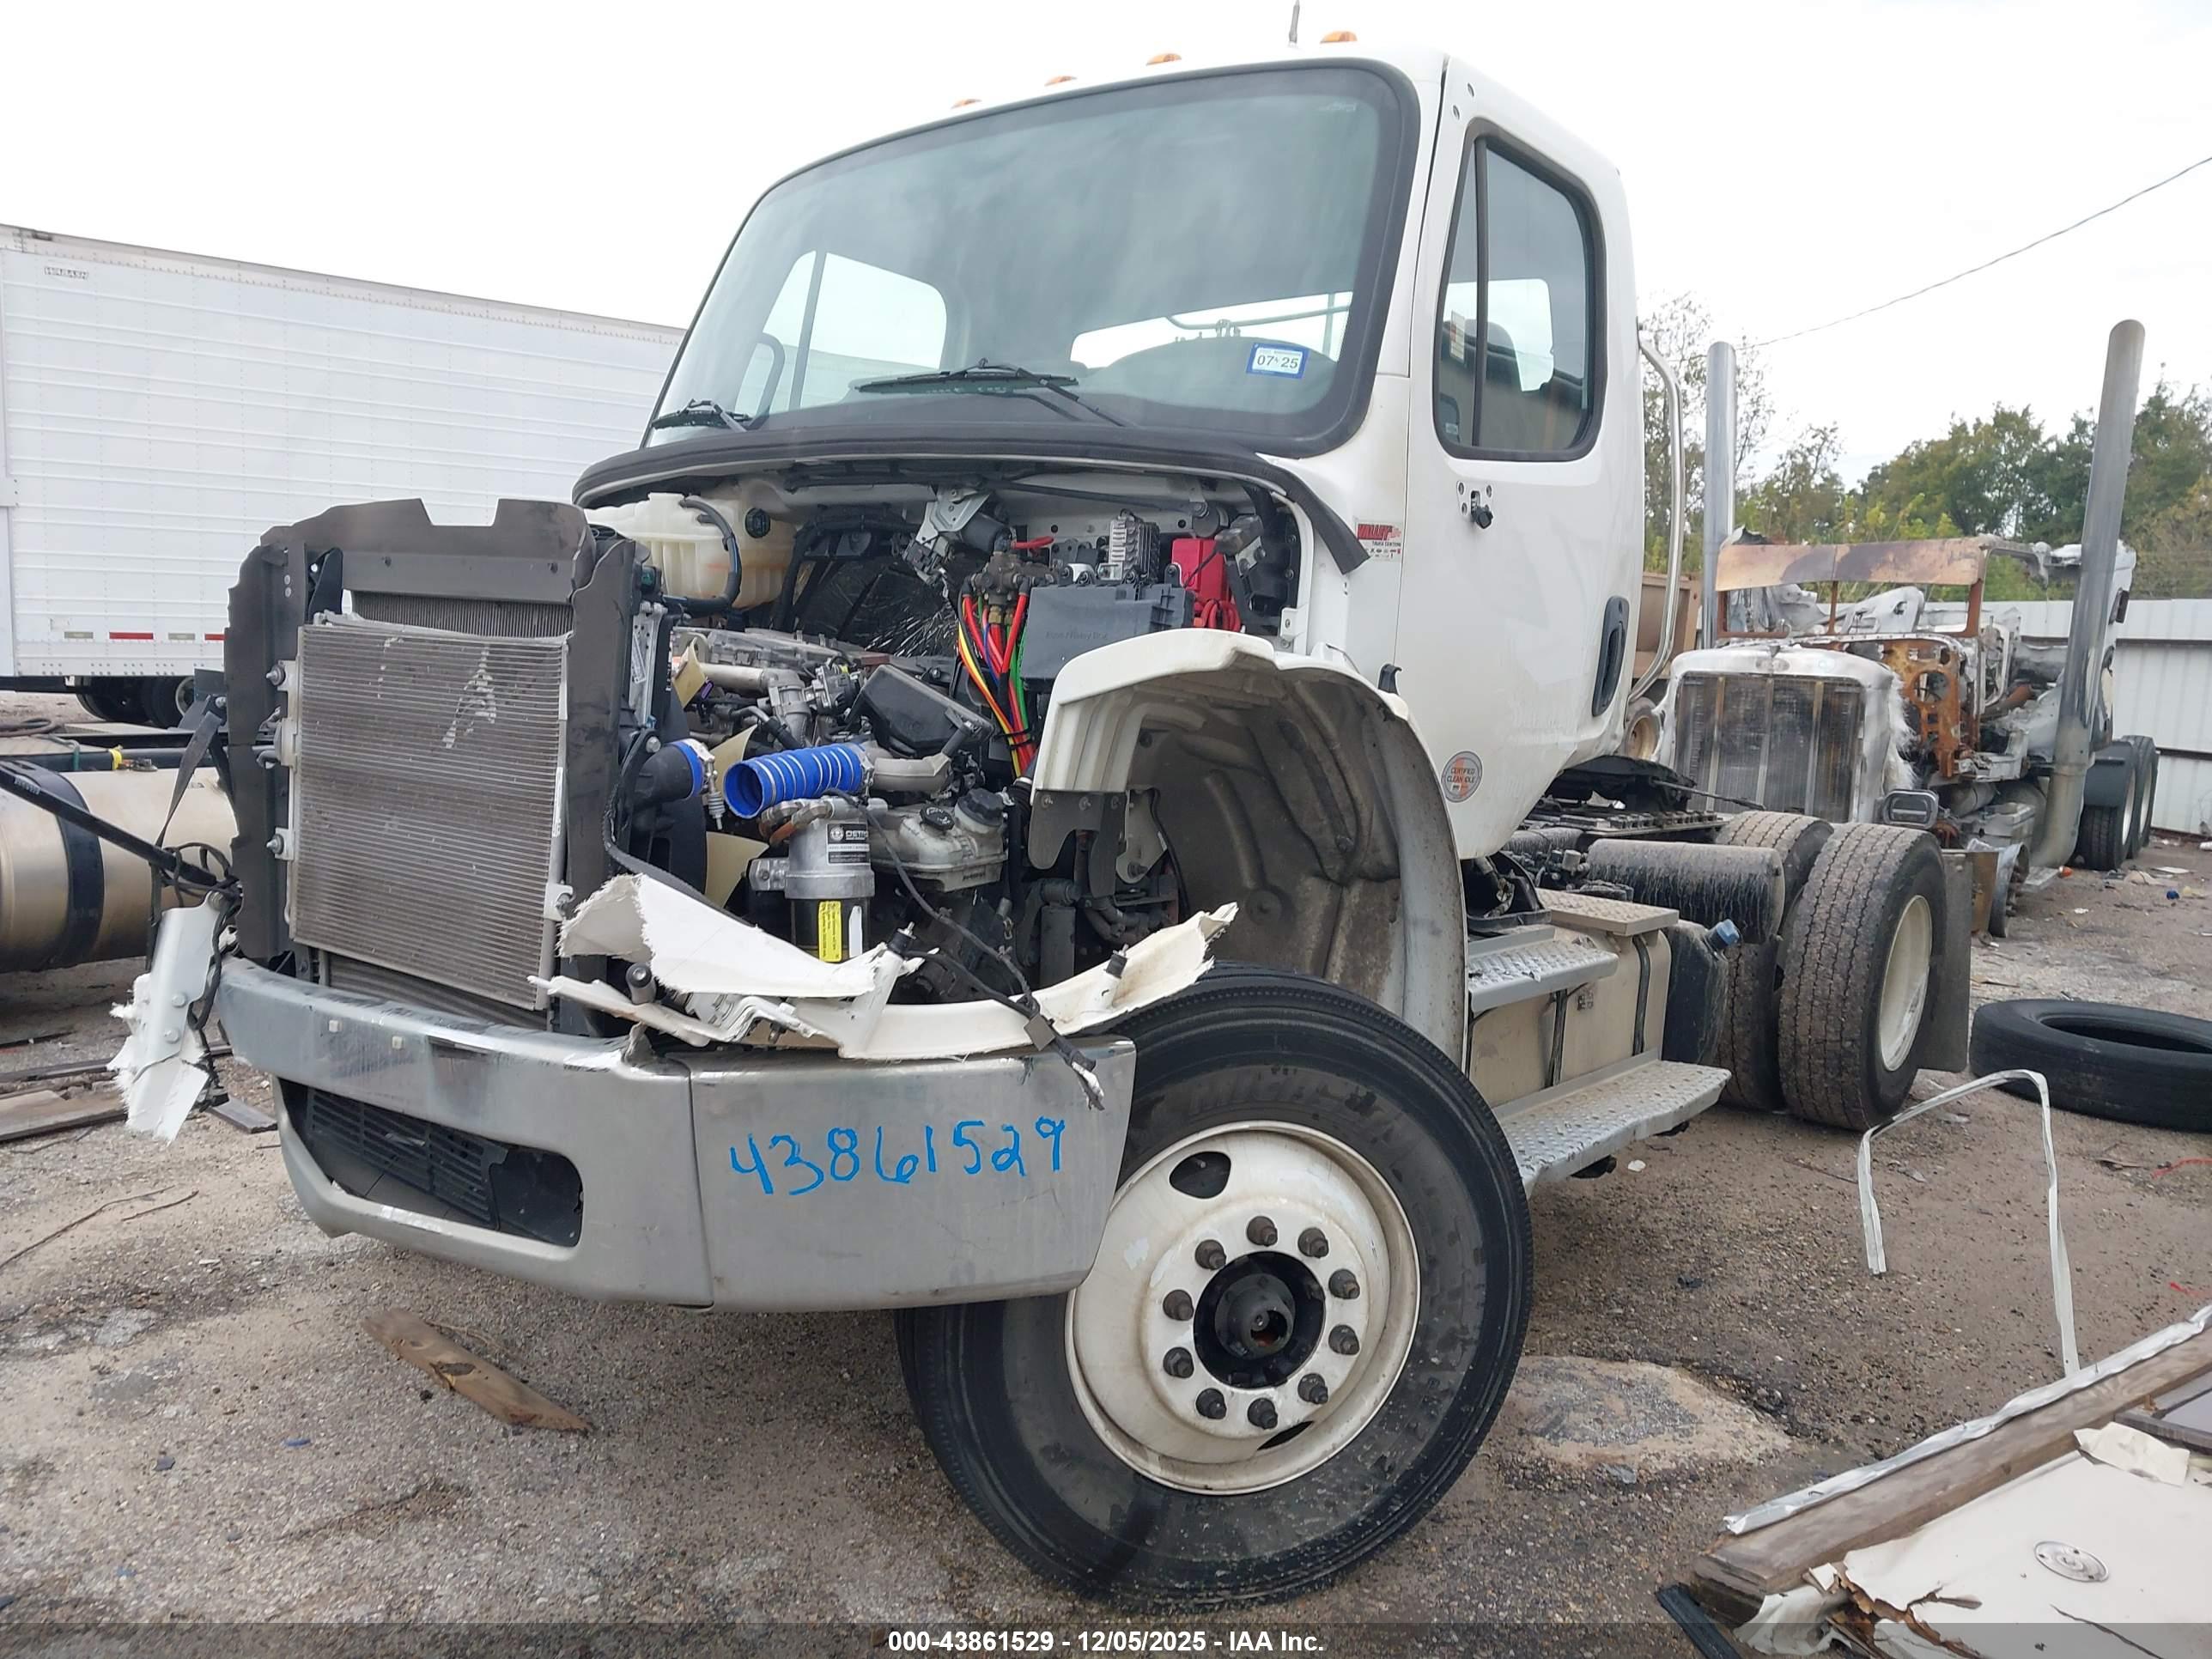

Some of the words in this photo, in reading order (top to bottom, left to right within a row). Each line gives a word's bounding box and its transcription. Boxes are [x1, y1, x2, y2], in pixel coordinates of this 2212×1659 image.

[1257, 355, 1274, 366] 07
[1280, 356, 1299, 369] 25
[730, 1116, 1065, 1195] 43861529
